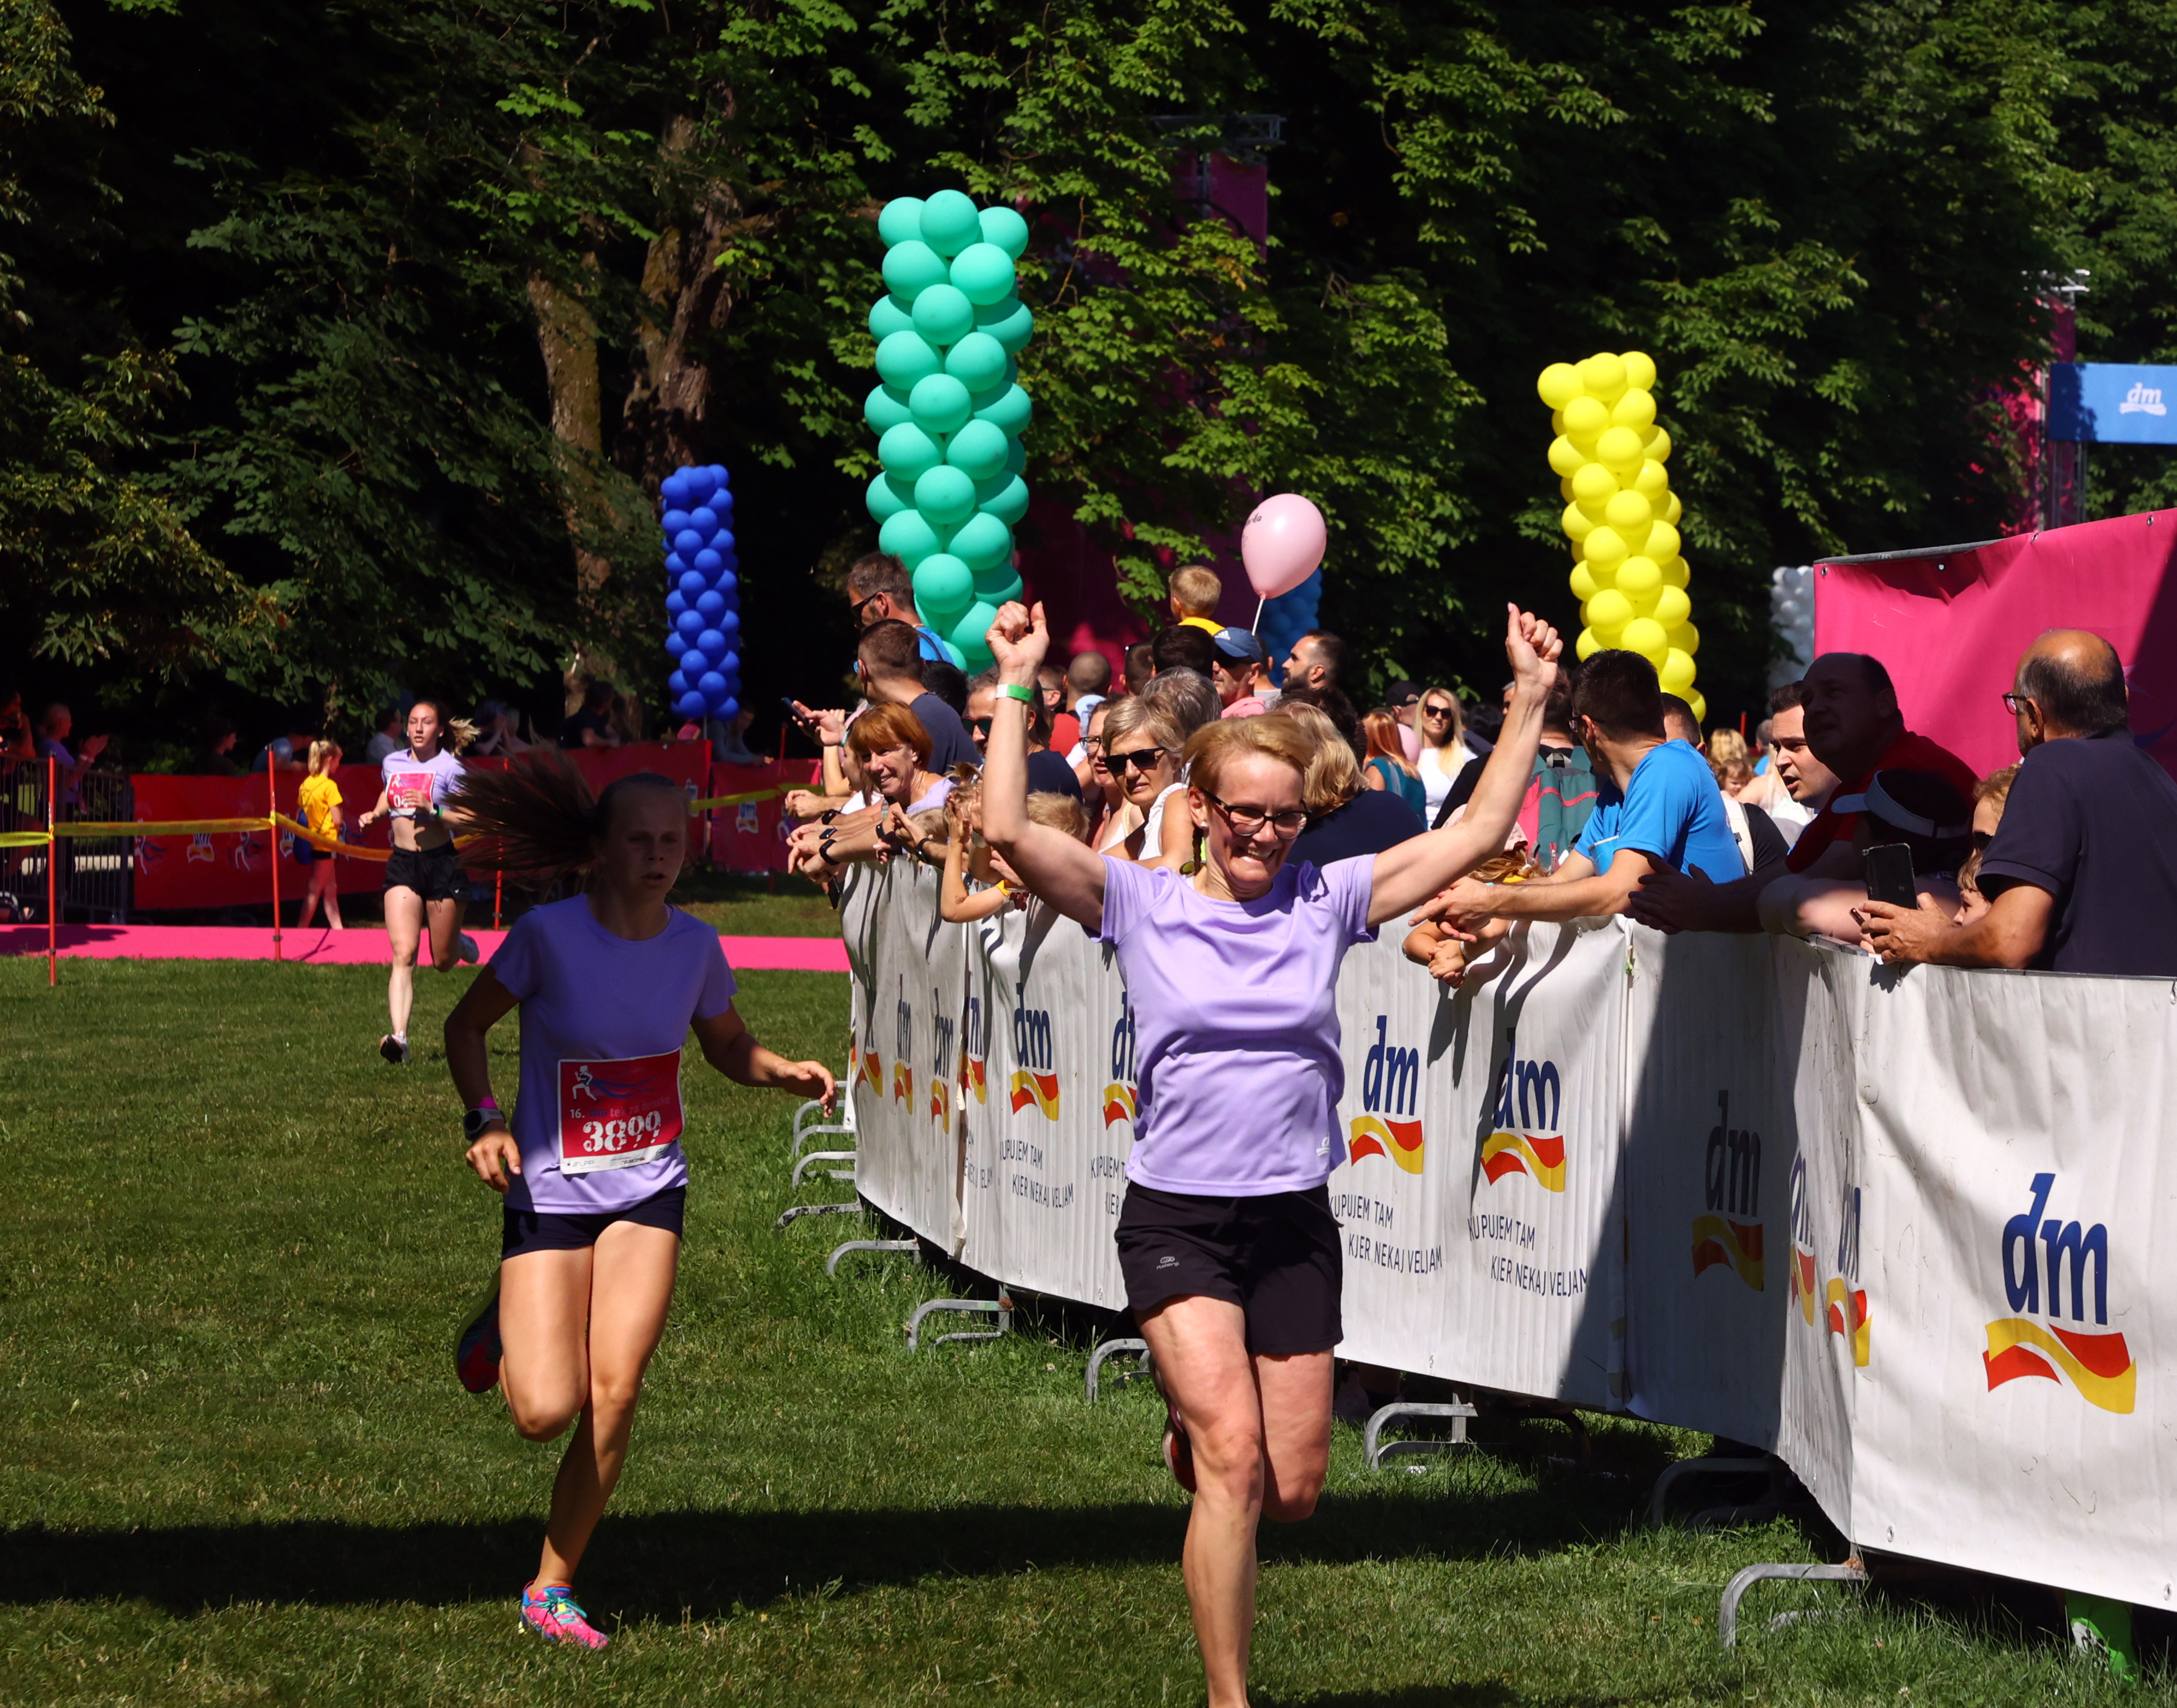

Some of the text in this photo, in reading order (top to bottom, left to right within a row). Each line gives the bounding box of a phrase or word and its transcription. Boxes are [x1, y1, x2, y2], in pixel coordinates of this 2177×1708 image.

[2127, 382, 2162, 404] dm
[898, 974, 911, 1063] dm
[934, 988, 953, 1079] dm
[1014, 983, 1052, 1070] dm
[1363, 1015, 1419, 1116] dm
[1493, 1027, 1560, 1131] dm
[570, 1109, 585, 1118] 16.
[610, 1107, 625, 1117] tek
[583, 1111, 661, 1152] 3899
[1031, 1145, 1042, 1170] TAM
[1091, 1156, 1119, 1180] KUPUJEM
[1705, 1090, 1761, 1217] dm
[1012, 1174, 1073, 1209] KJER NEKAJ VELJAM
[1329, 1194, 1393, 1230] KUPUJEM TAM
[1468, 1214, 1535, 1251] KUPUJEM TAM
[2002, 1173, 2108, 1325] dm
[1348, 1233, 1442, 1275] KJER NEKAJ VELJAM
[1491, 1255, 1588, 1297] KJER NEKAJ VELJAM
